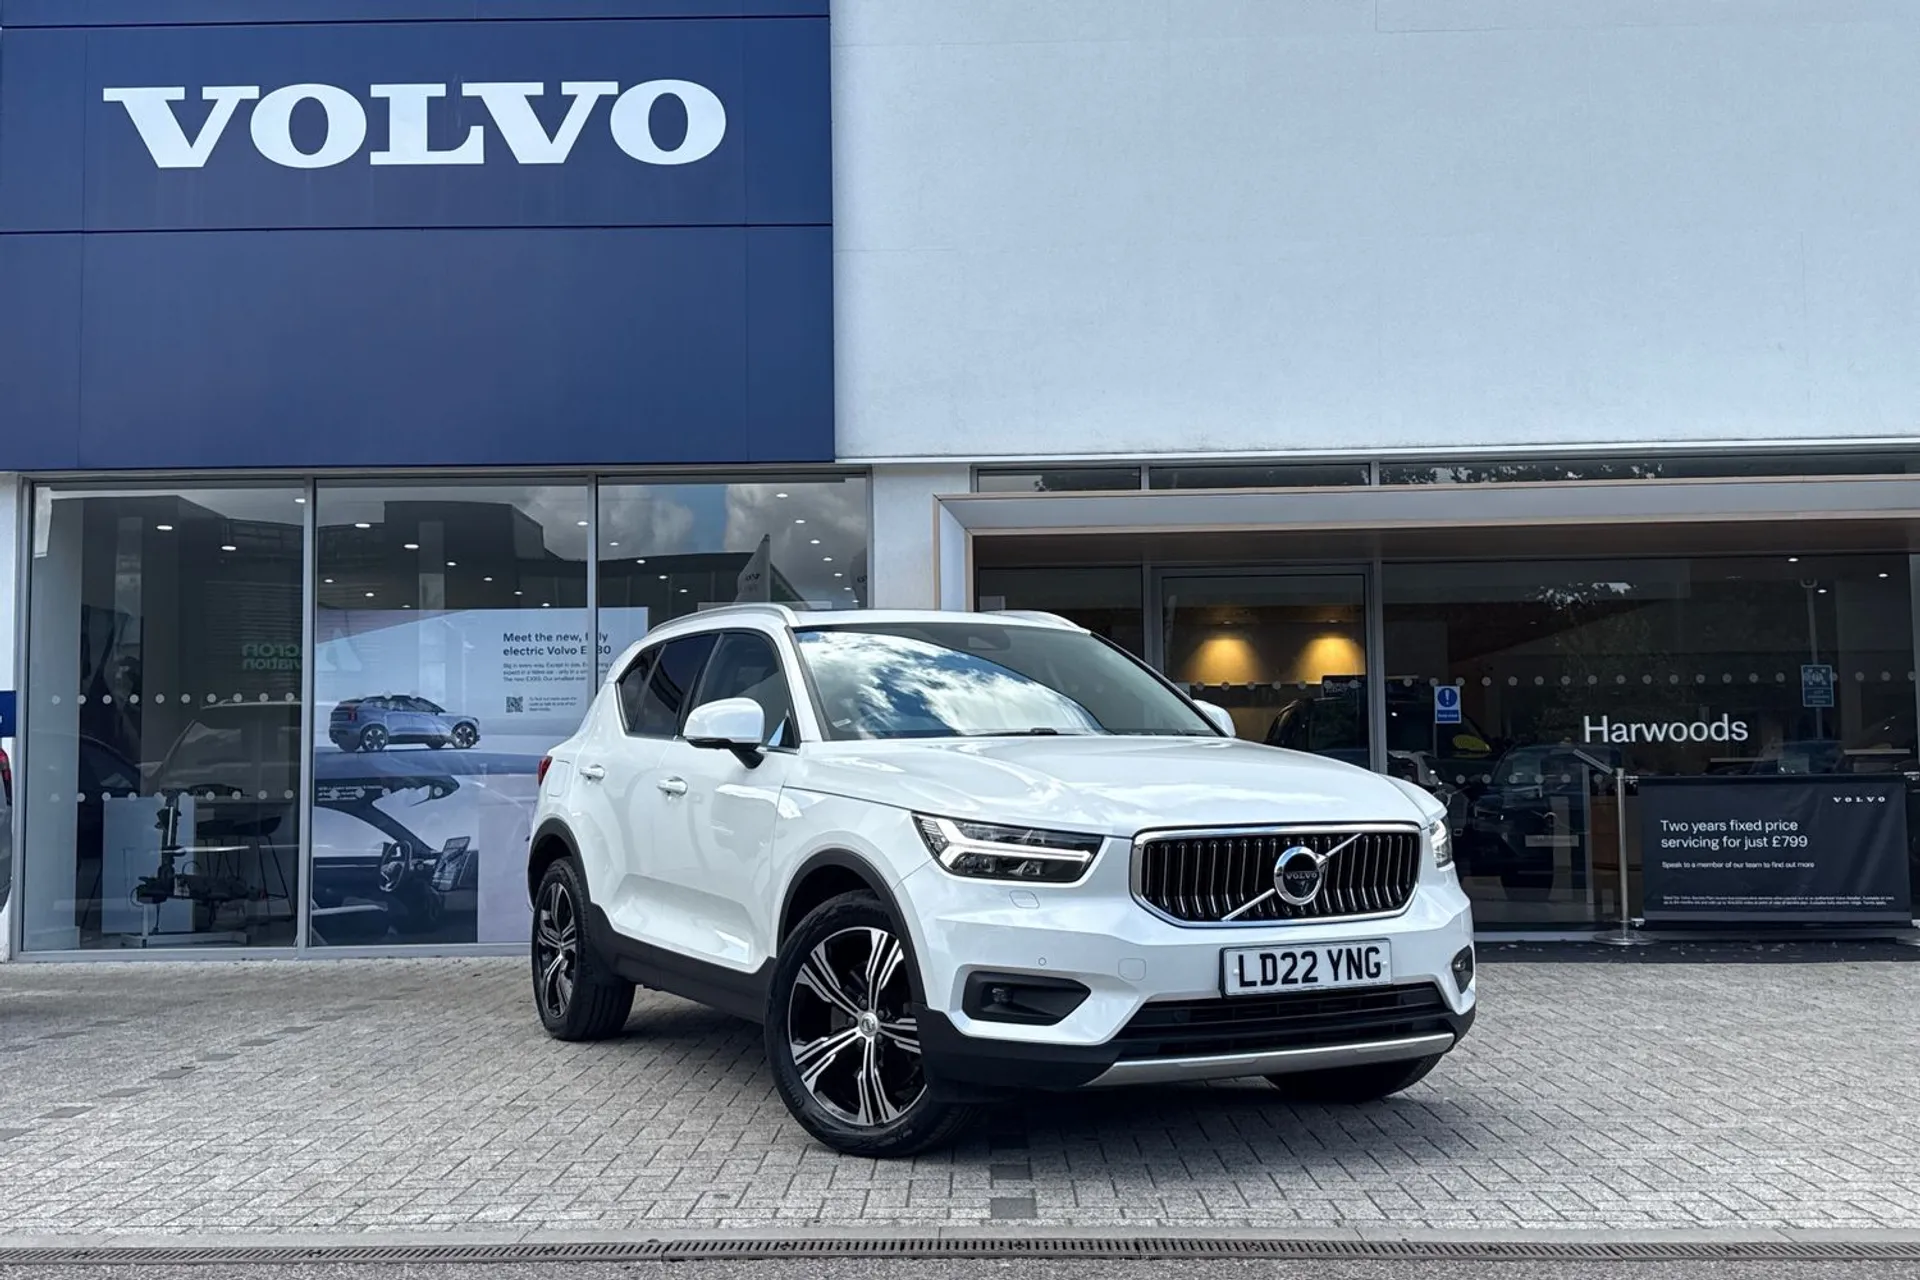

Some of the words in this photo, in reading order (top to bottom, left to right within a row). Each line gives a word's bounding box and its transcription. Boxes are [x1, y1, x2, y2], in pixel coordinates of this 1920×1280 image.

[103, 79, 727, 169] VOLVO
[503, 633, 532, 642] Meet
[535, 632, 553, 642] the
[555, 633, 582, 643] new,
[503, 646, 544, 656] electric
[547, 645, 577, 656] Volvo
[580, 645, 612, 655] E30
[1583, 712, 1749, 744] Harwoods
[1660, 819, 1689, 832] Two
[1691, 821, 1727, 834] years
[1729, 819, 1762, 831] fixed
[1765, 819, 1799, 833] price
[1661, 835, 1720, 851] servicing
[1721, 835, 1742, 848] for
[1743, 835, 1769, 851] just
[1771, 835, 1808, 848] £799
[1661, 861, 1682, 870] Speak
[1696, 861, 1723, 869] member
[1285, 872, 1318, 880] VOLVO
[1237, 950, 1319, 988] LD22
[1326, 946, 1382, 982] YNG
